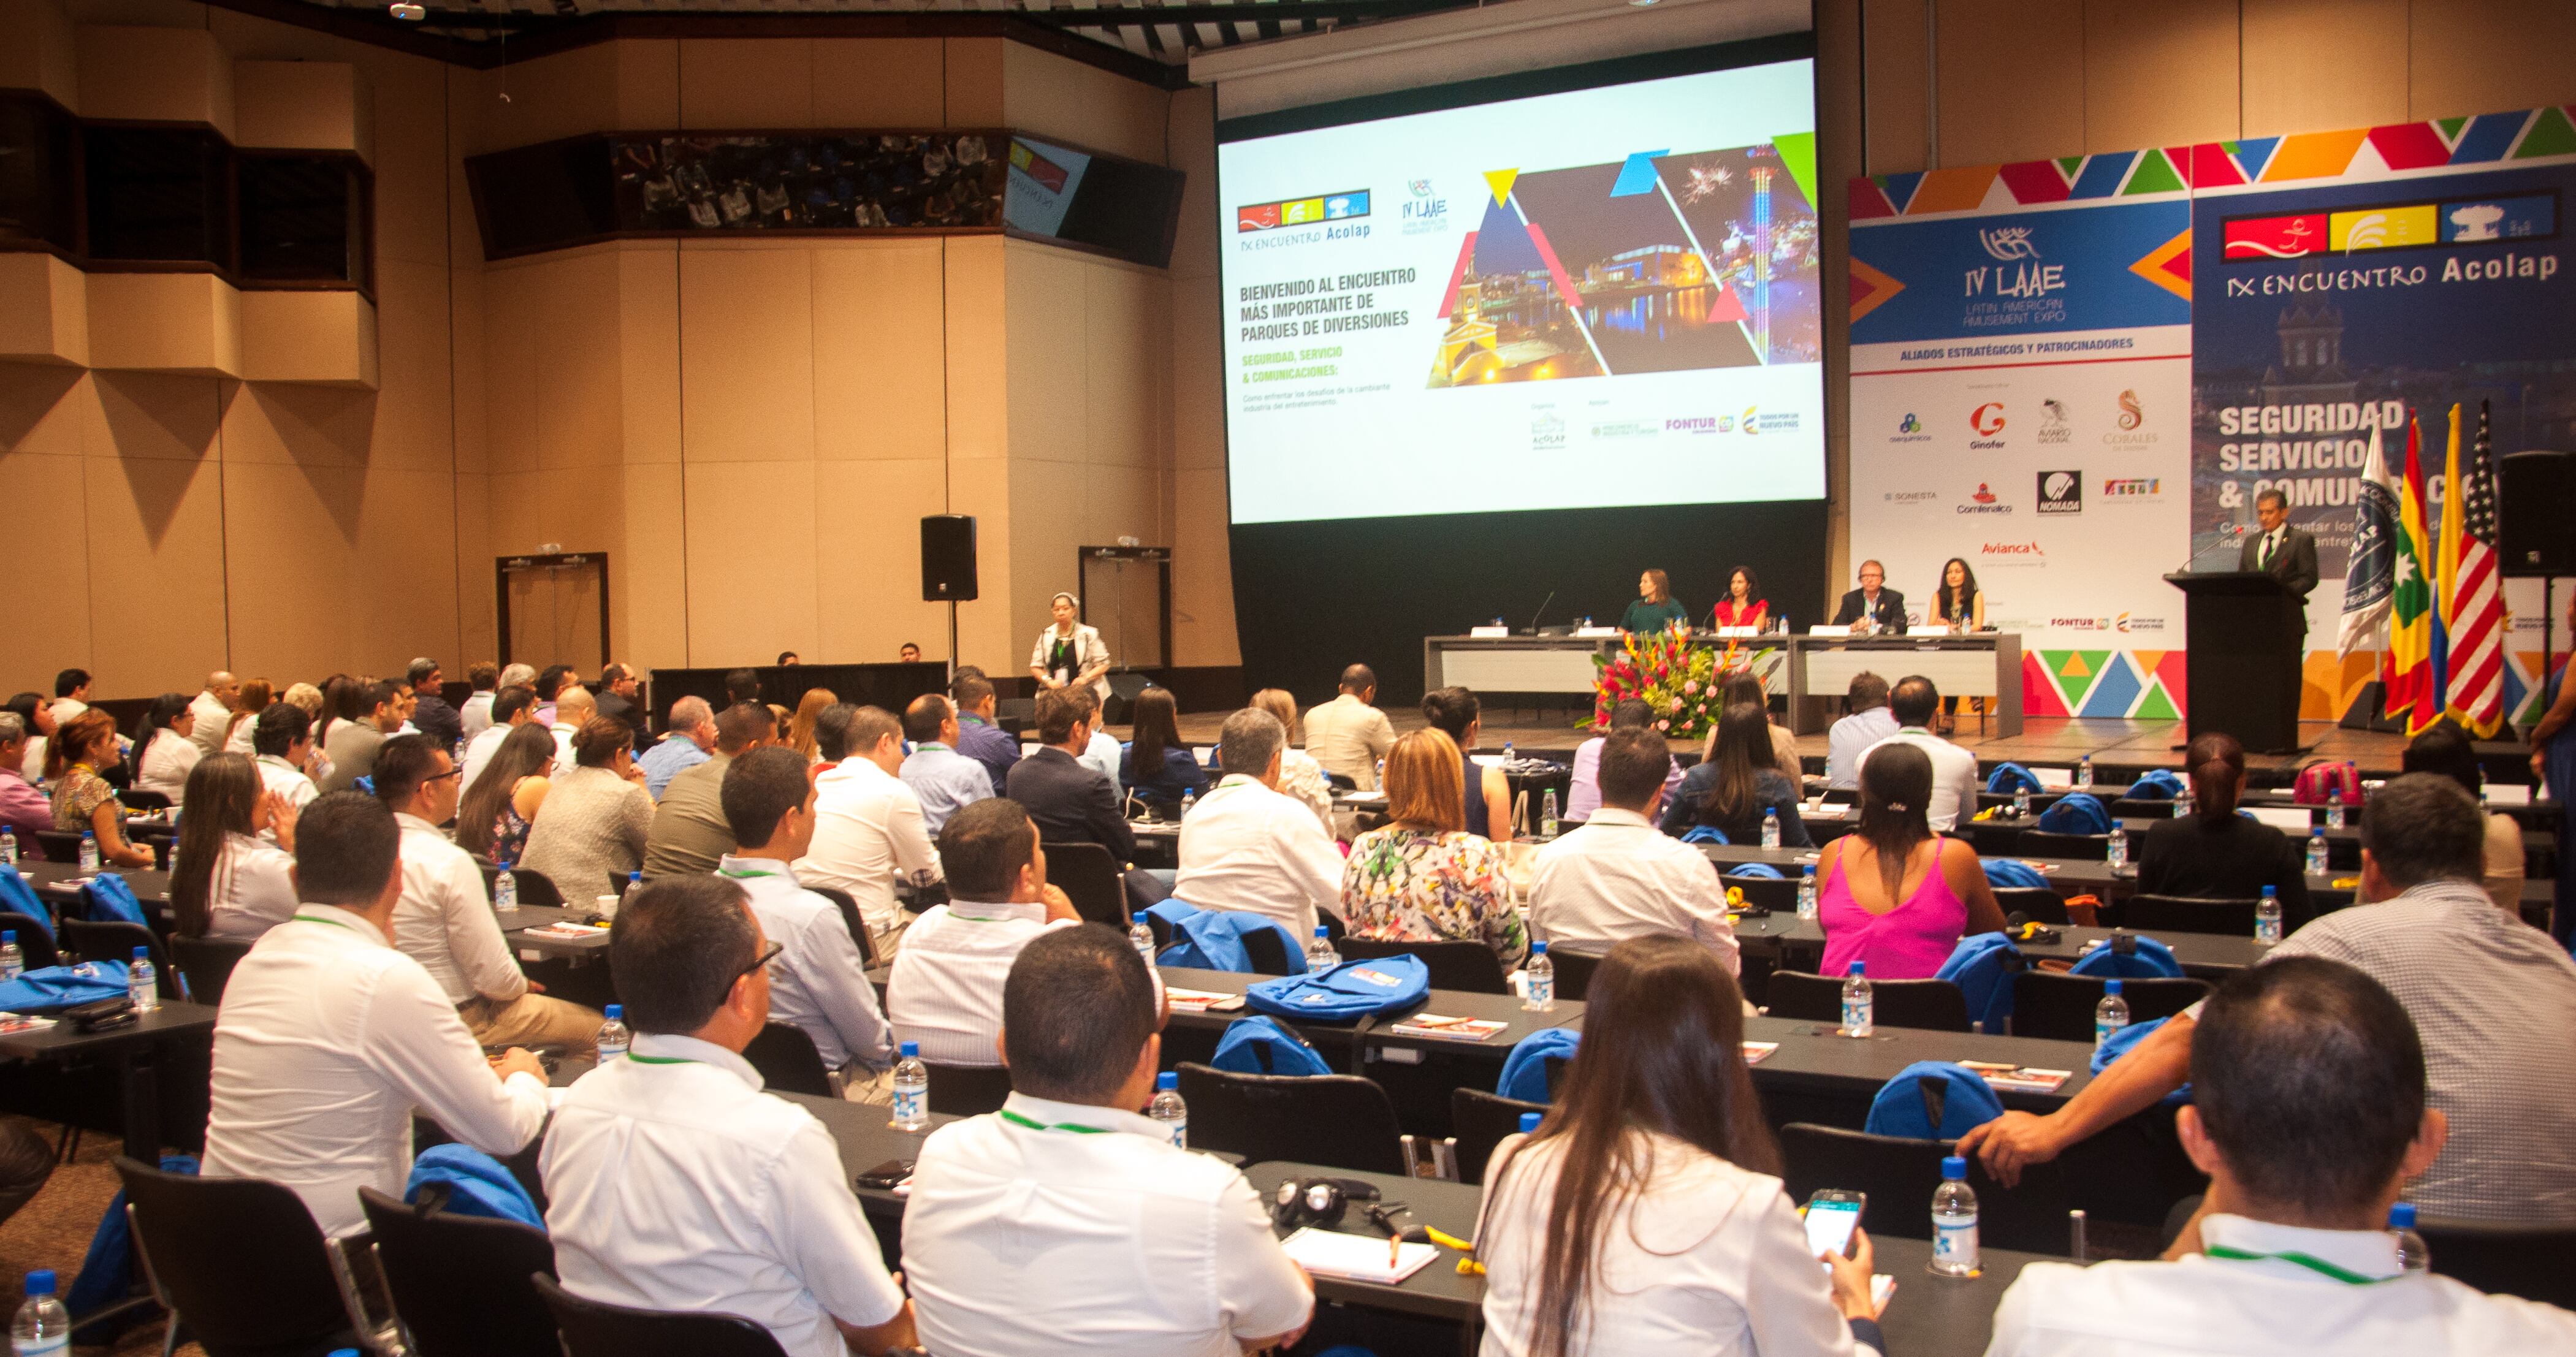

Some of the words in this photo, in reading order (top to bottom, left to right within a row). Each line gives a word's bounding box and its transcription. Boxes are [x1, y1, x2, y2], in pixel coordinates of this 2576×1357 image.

[1403, 202, 1412, 219] IV
[1416, 199, 1447, 218] LAAE
[1241, 241, 1253, 252] IX
[1255, 232, 1321, 249] ENCUENTRO
[1327, 224, 1370, 240] Acolap
[1240, 279, 1314, 302] BIENVENIDO
[1319, 277, 1334, 293] AL
[1338, 267, 1416, 291] ENCUENTRO
[1965, 267, 1988, 297] IV
[1996, 262, 2066, 298] LAAE
[2227, 278, 2255, 297] IX
[2263, 265, 2426, 295] ENCUENTRO
[2441, 253, 2558, 283] Acolap
[1241, 303, 1268, 322] MÁS
[1273, 295, 1352, 318] IMPORTANTE
[1357, 293, 1373, 309] DE
[1966, 303, 1998, 315] LATIN
[2003, 298, 2063, 313] AMERICAN
[1241, 322, 1298, 342] PARQUES
[1303, 320, 1319, 336] DE
[1324, 310, 1409, 334] DIVERSIONES
[1963, 313, 2028, 327] AMUSEMENT
[2034, 310, 2066, 324] EXPO
[1242, 351, 1297, 367] SEGURIDAD,
[1300, 346, 1343, 361] SERVICIO
[1900, 348, 1944, 361] ALIADOS
[1948, 343, 2024, 359] ESTRATÉGICOS
[2027, 343, 2033, 354] Y
[2037, 338, 2133, 354] PATROCINADORES
[1243, 373, 1249, 384] &
[1252, 365, 1338, 383] COMUNICACIONES:
[1243, 393, 1263, 403] Como
[1264, 391, 1293, 401] enfrentar
[1295, 389, 1305, 398] los
[1355, 383, 1390, 393] cambiante
[1243, 403, 1271, 412] industria
[1273, 401, 1283, 410] del
[1666, 417, 1716, 430] FONTUR
[2219, 400, 2405, 436] SEGURIDAD
[1533, 435, 1565, 444] ACOLAP
[1970, 440, 2005, 450] Ginofer
[2219, 439, 2369, 473] SERVICIO
[1894, 492, 1937, 500] SONESTA
[2219, 480, 2243, 508] &
[1957, 504, 2013, 515] Comfenalco
[2039, 500, 2080, 512] NOMADA
[1981, 542, 2030, 555] Avianca
[2051, 618, 2094, 626] FONTUR
